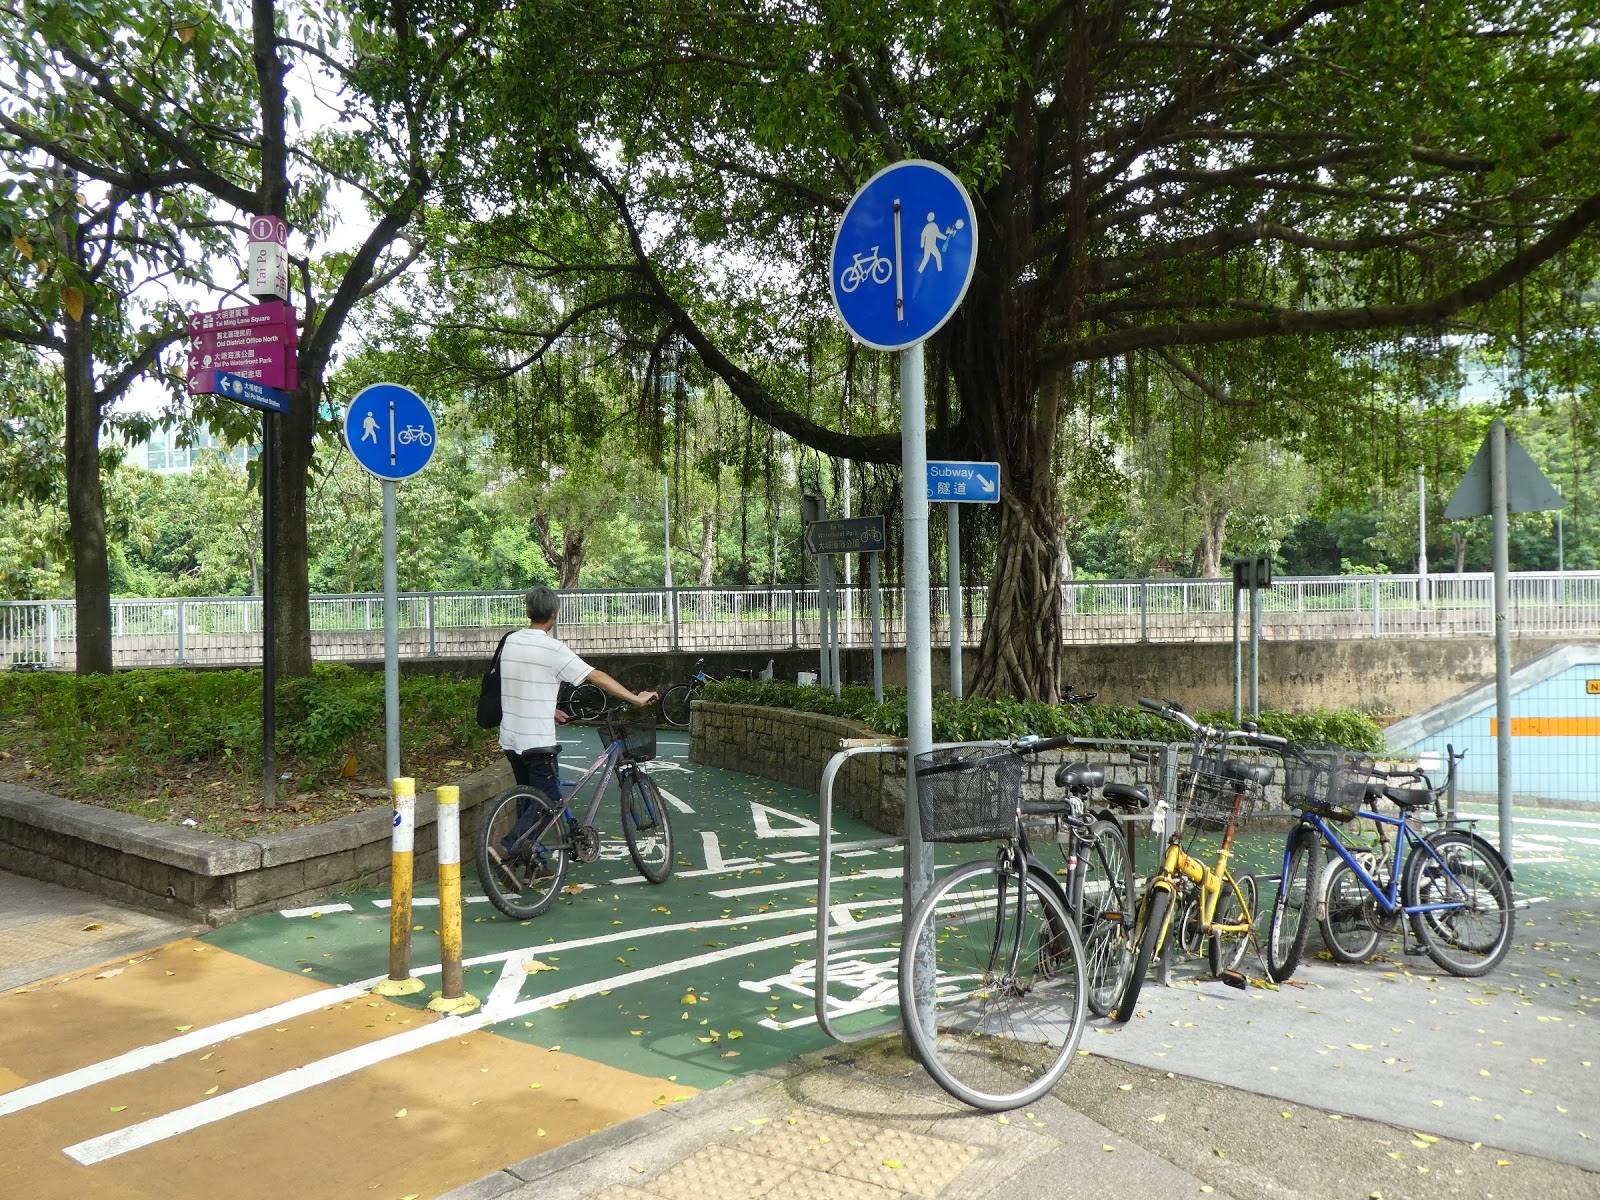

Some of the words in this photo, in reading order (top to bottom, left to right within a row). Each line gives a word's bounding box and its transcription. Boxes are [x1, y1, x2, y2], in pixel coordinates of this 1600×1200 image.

[256, 249, 267, 263] Po
[256, 268, 267, 287] Tai
[275, 251, 287, 295] 大埔
[223, 319, 237, 327] Ming
[250, 315, 271, 323] Square
[226, 338, 246, 346] District
[230, 358, 259, 366] Waterfront
[930, 466, 974, 480] Subway
[937, 481, 967, 496] 隧道
